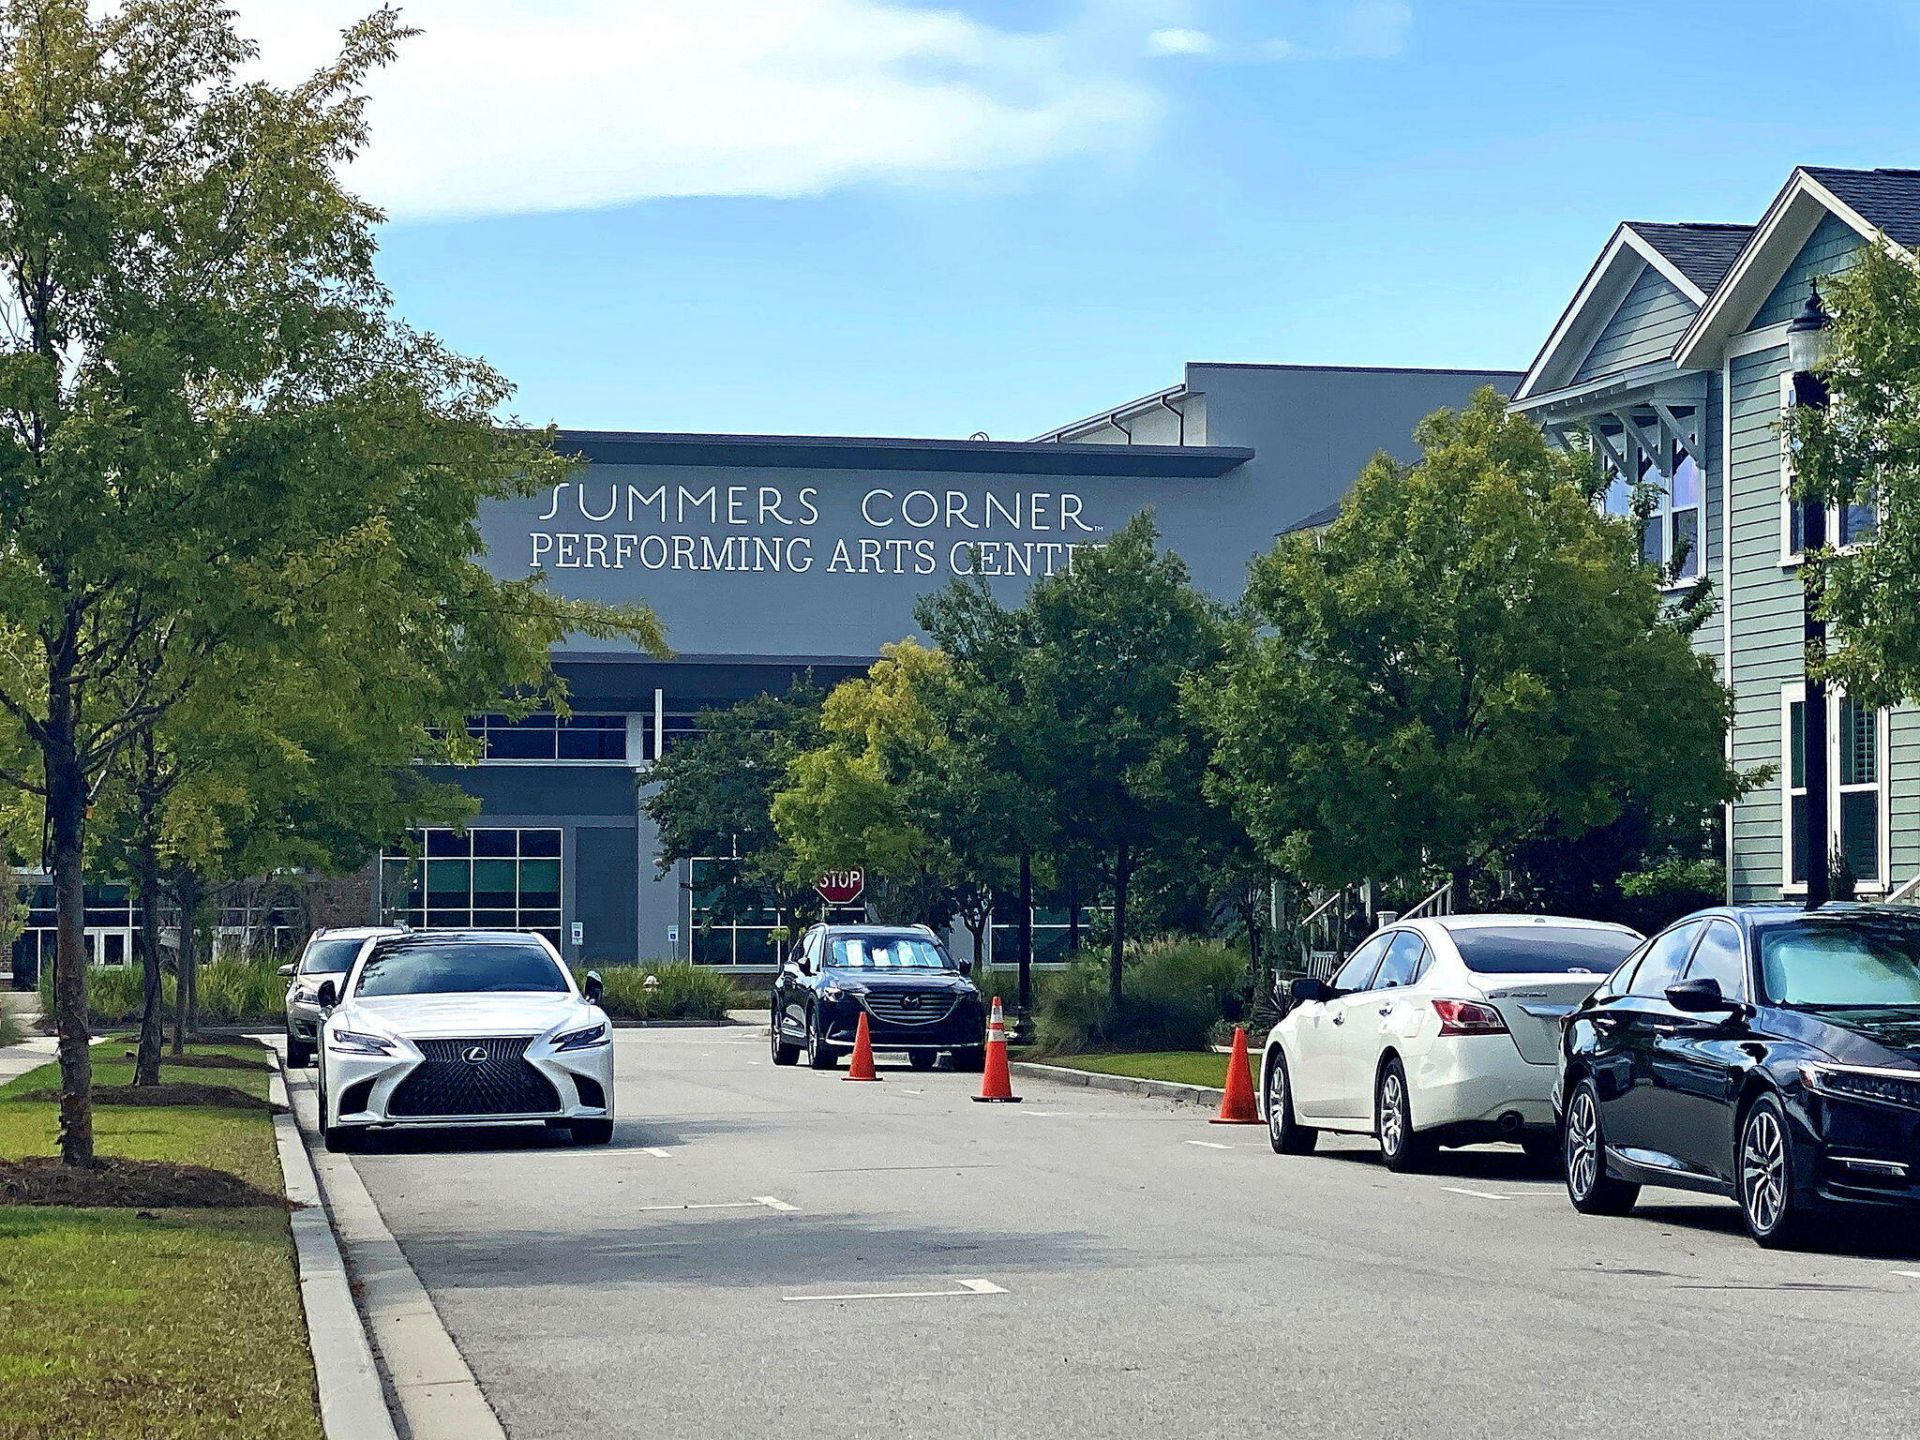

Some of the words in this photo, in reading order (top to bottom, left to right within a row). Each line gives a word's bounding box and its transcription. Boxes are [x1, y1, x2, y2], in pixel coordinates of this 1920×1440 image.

[539, 482, 819, 525] SUMMERS
[861, 489, 1093, 532] CORNER
[529, 532, 814, 573] PERFORMING
[826, 538, 937, 575] ARTS
[819, 870, 861, 888] STOP
